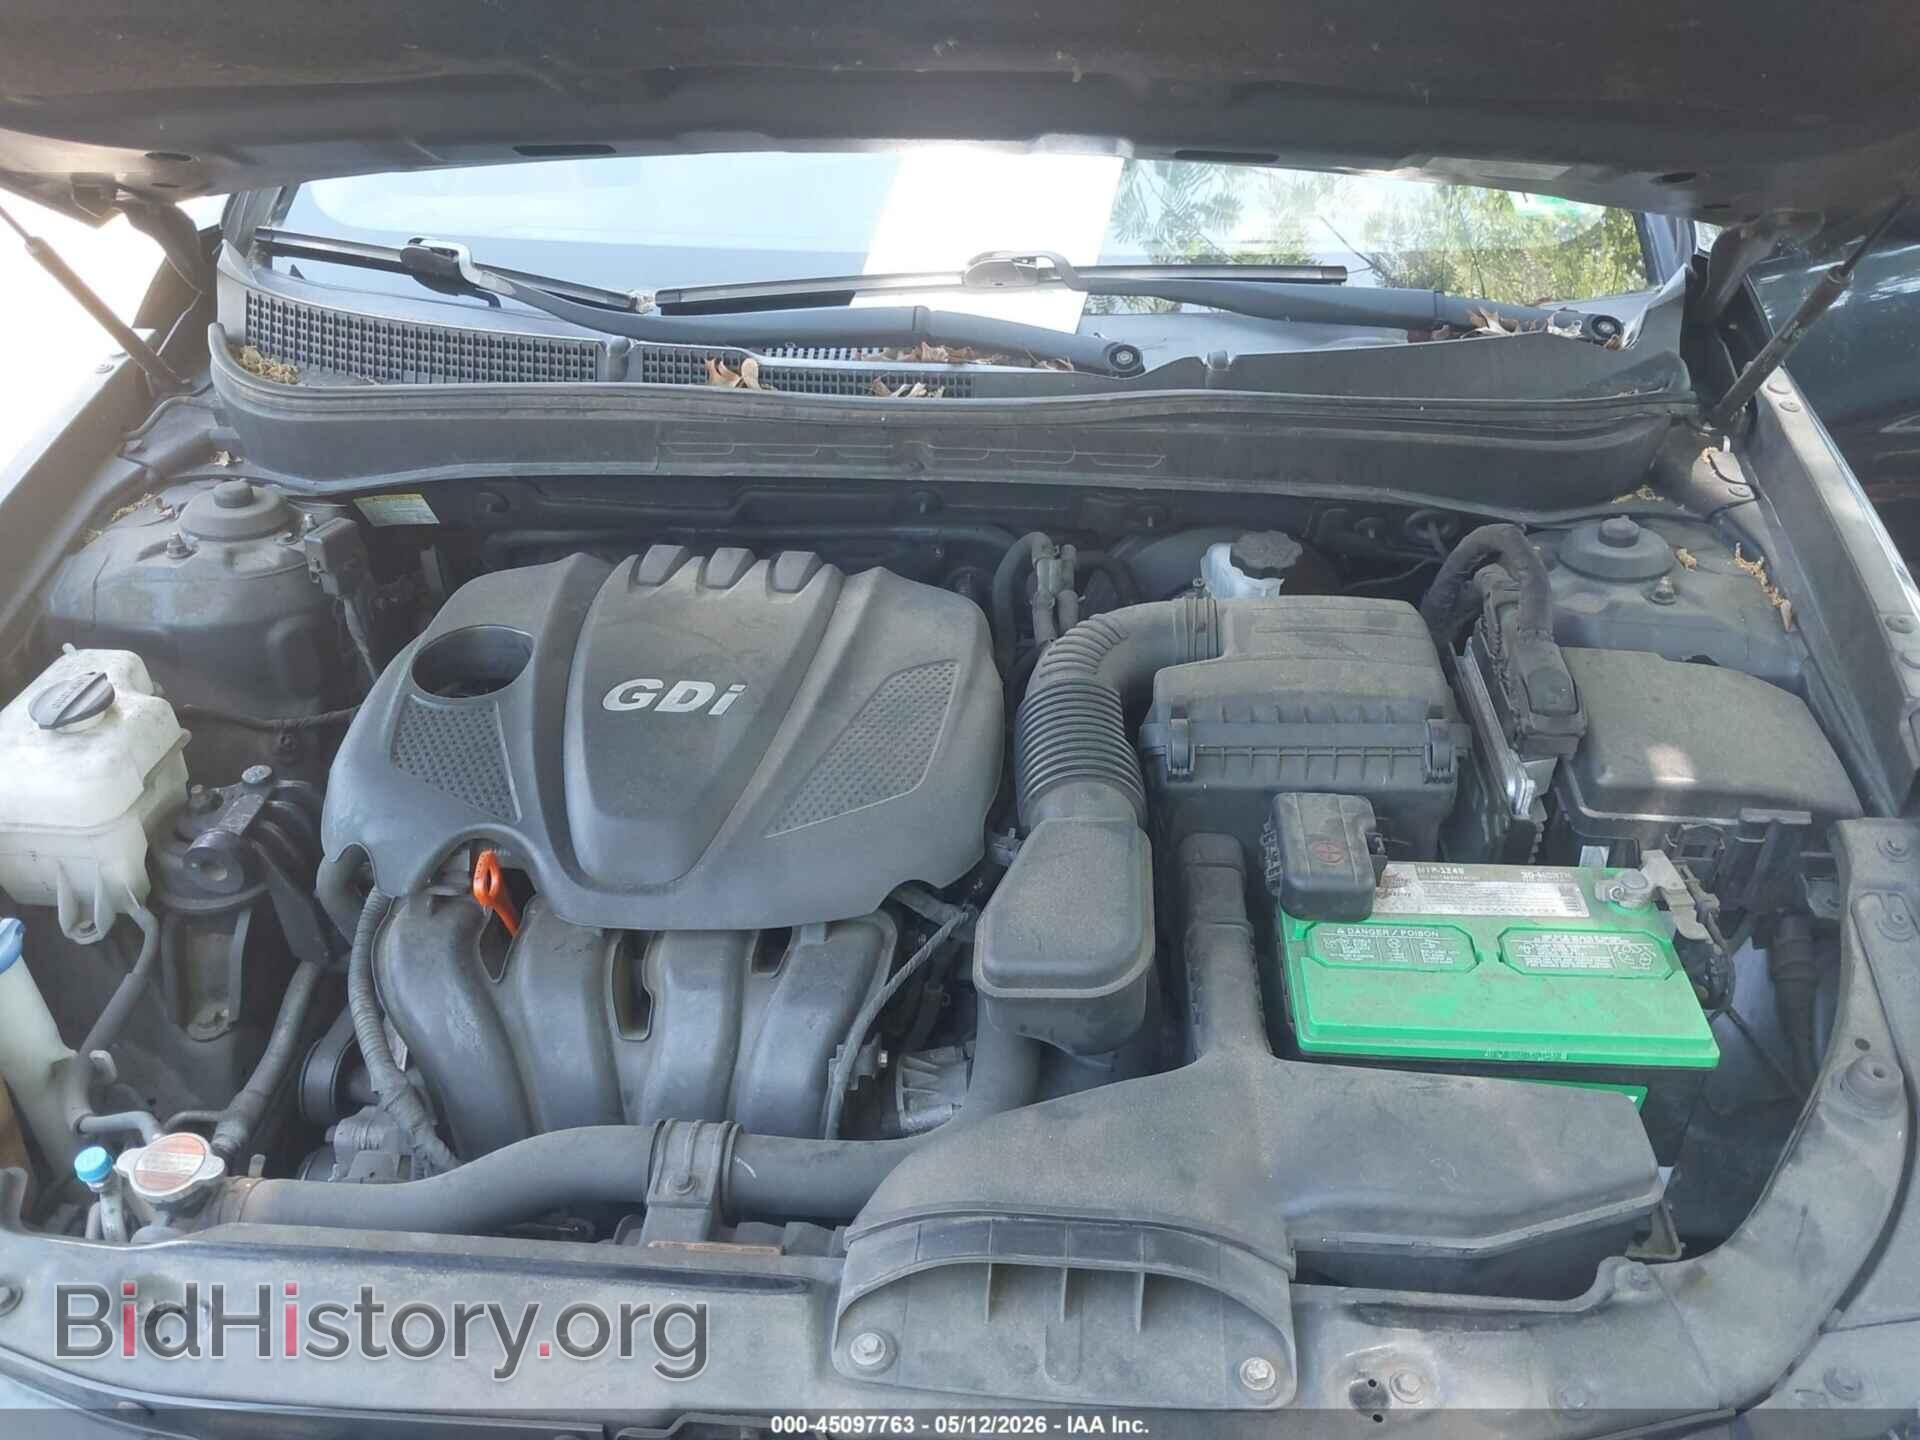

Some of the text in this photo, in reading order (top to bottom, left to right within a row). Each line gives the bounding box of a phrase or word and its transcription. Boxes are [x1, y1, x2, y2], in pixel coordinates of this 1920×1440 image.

[602, 678, 747, 715] GDi
[1347, 928, 1389, 937] DANGER
[1400, 929, 1439, 938] POISON
